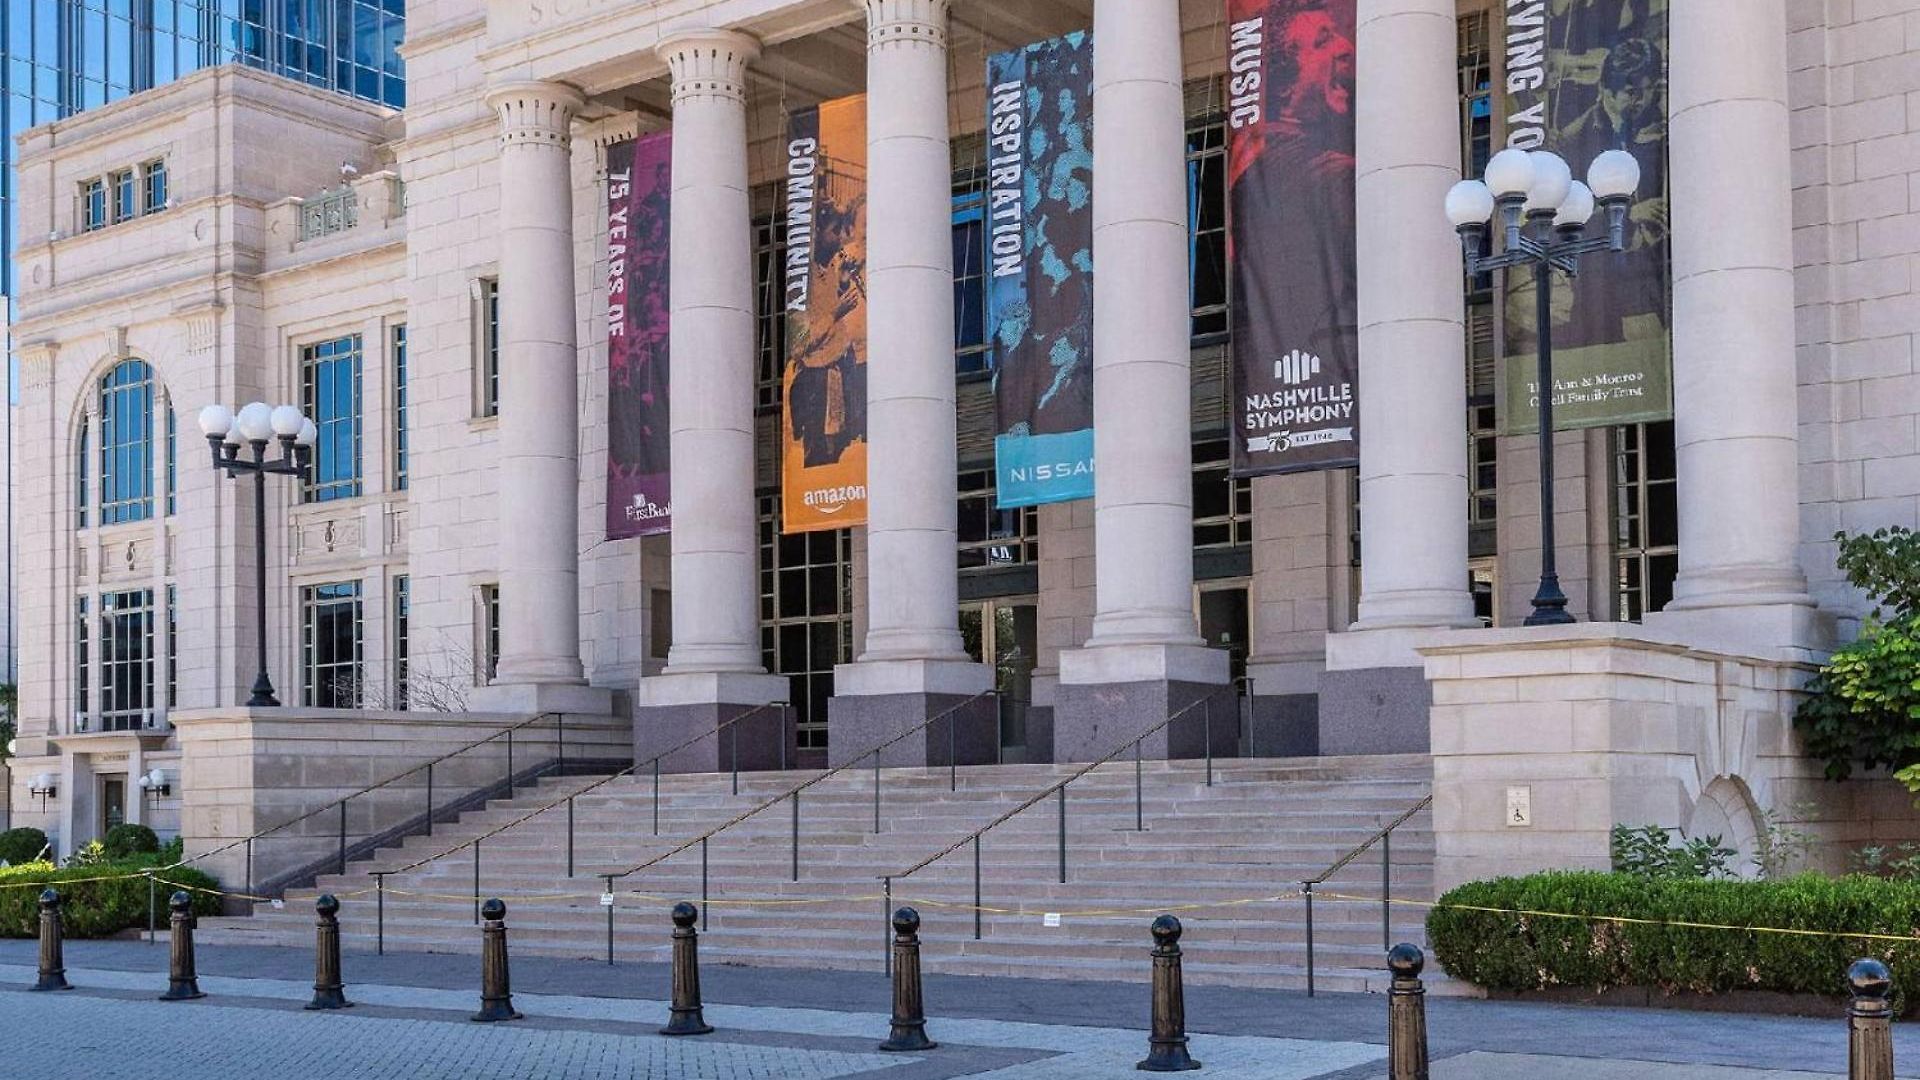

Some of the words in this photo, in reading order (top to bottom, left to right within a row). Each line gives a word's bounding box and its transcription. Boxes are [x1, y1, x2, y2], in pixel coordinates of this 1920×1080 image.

[1230, 17, 1262, 129] MUSIC
[1507, 101, 1545, 150] YO
[610, 166, 632, 200] 75
[992, 80, 1022, 277] INSPIRATION
[787, 137, 816, 312] COMMUNITY
[608, 206, 627, 297] YEARS
[608, 304, 624, 337] OF
[1246, 383, 1352, 411] NASHVILLE
[1246, 401, 1354, 430] SYMPHONY
[1267, 430, 1290, 453] 75
[803, 485, 866, 506] amazon
